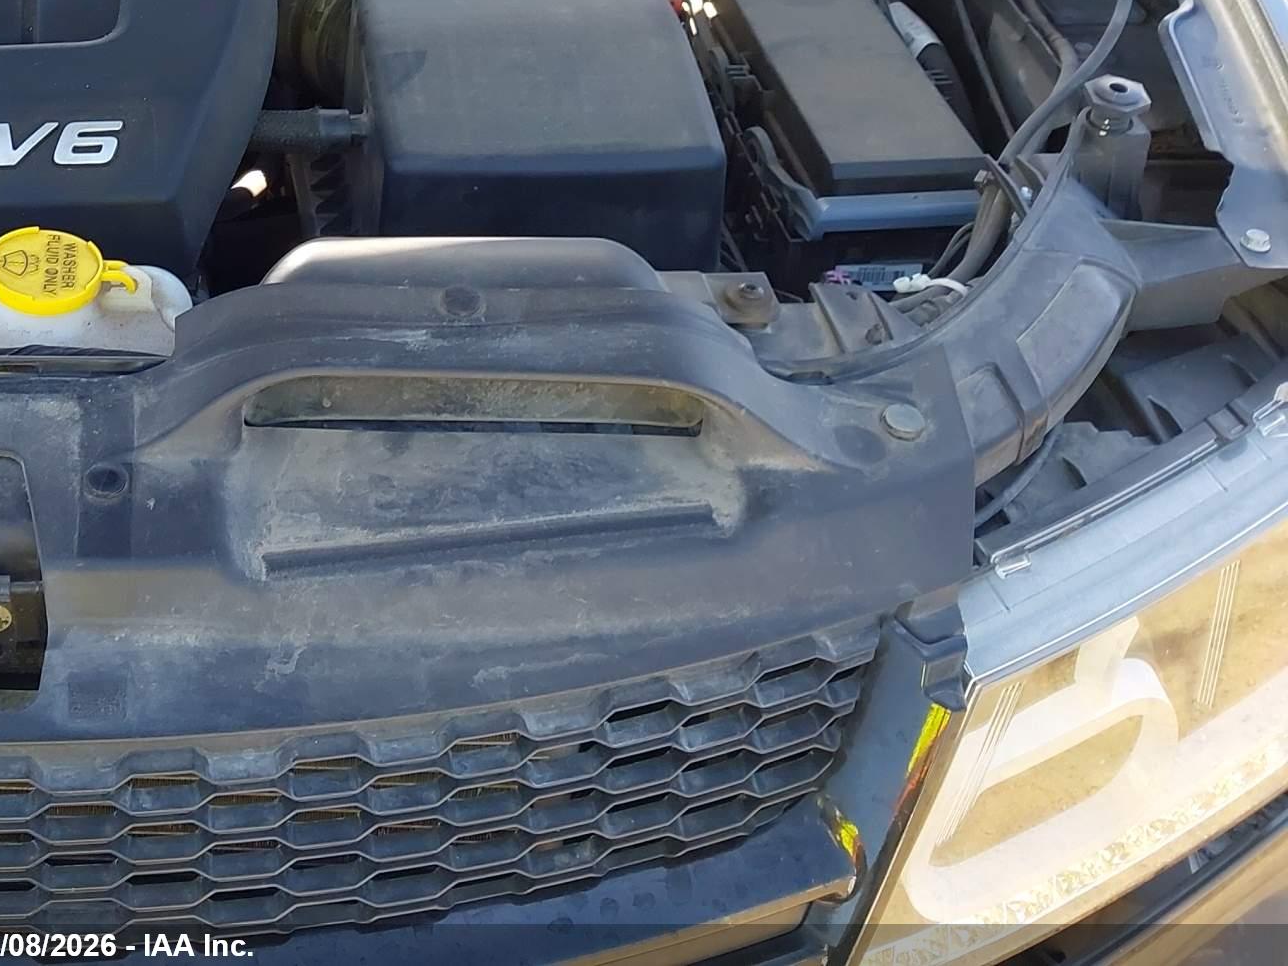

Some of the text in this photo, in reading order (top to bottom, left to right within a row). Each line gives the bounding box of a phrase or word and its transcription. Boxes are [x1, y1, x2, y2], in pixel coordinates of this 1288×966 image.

[42, 234, 61, 297] FLUID ONLY
[61, 242, 77, 289] WASHER
